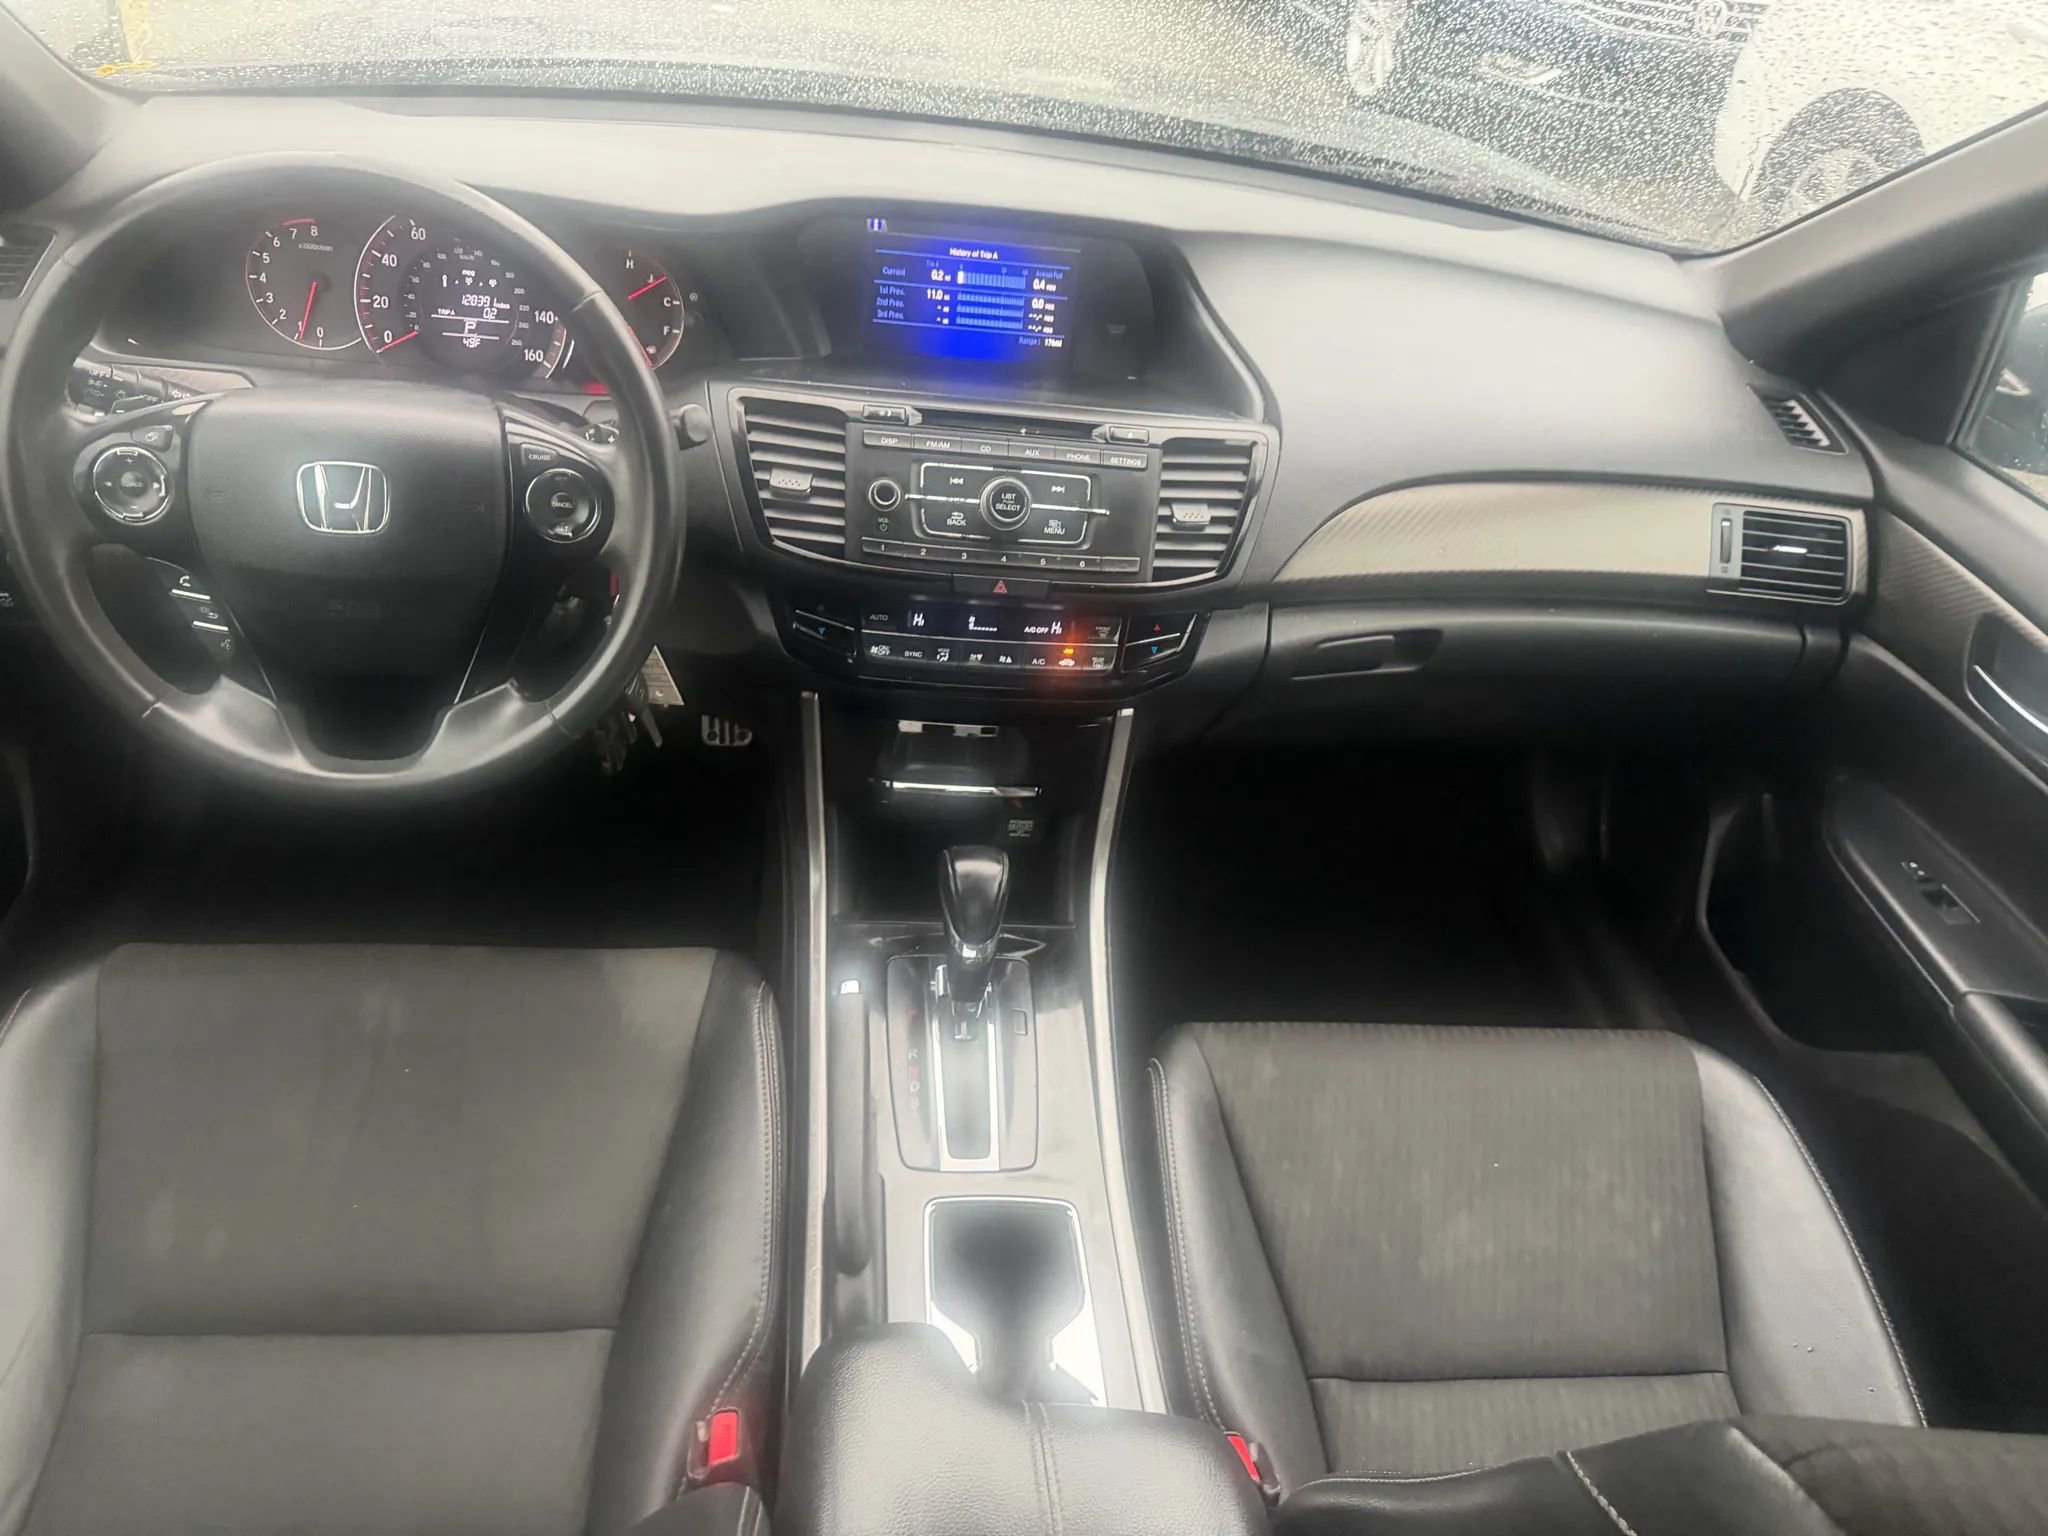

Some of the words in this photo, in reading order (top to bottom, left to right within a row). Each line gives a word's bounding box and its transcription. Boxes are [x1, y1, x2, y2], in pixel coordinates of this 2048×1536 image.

[289, 228, 298, 240] 7
[310, 226, 318, 236] 8
[411, 227, 426, 240] 60
[273, 237, 280, 248] 6
[262, 252, 270, 264] 5
[381, 254, 397, 267] 40
[625, 259, 634, 269] H
[259, 272, 267, 283] 4
[931, 269, 944, 281] 0.2
[265, 292, 273, 304] 3
[372, 295, 389, 308] 20
[663, 297, 671, 307] C
[279, 308, 287, 320] 2
[534, 311, 554, 325] 140
[297, 321, 302, 332] 1
[316, 326, 324, 337] 0
[464, 320, 477, 334] P
[663, 325, 670, 336] F
[383, 330, 392, 343] 0
[524, 349, 544, 363] 160
[880, 437, 898, 445] DISP
[926, 440, 951, 449] FM/AM
[528, 453, 551, 461] CRUISE
[1024, 449, 1040, 457] AUX
[1066, 453, 1091, 461] PHONE
[1110, 457, 1142, 466] SETTINGS
[995, 503, 1021, 512] SELECT
[946, 518, 967, 526] BACK
[1043, 527, 1066, 535] MENU
[904, 650, 923, 658] SYNC
[908, 1048, 919, 1060] R
